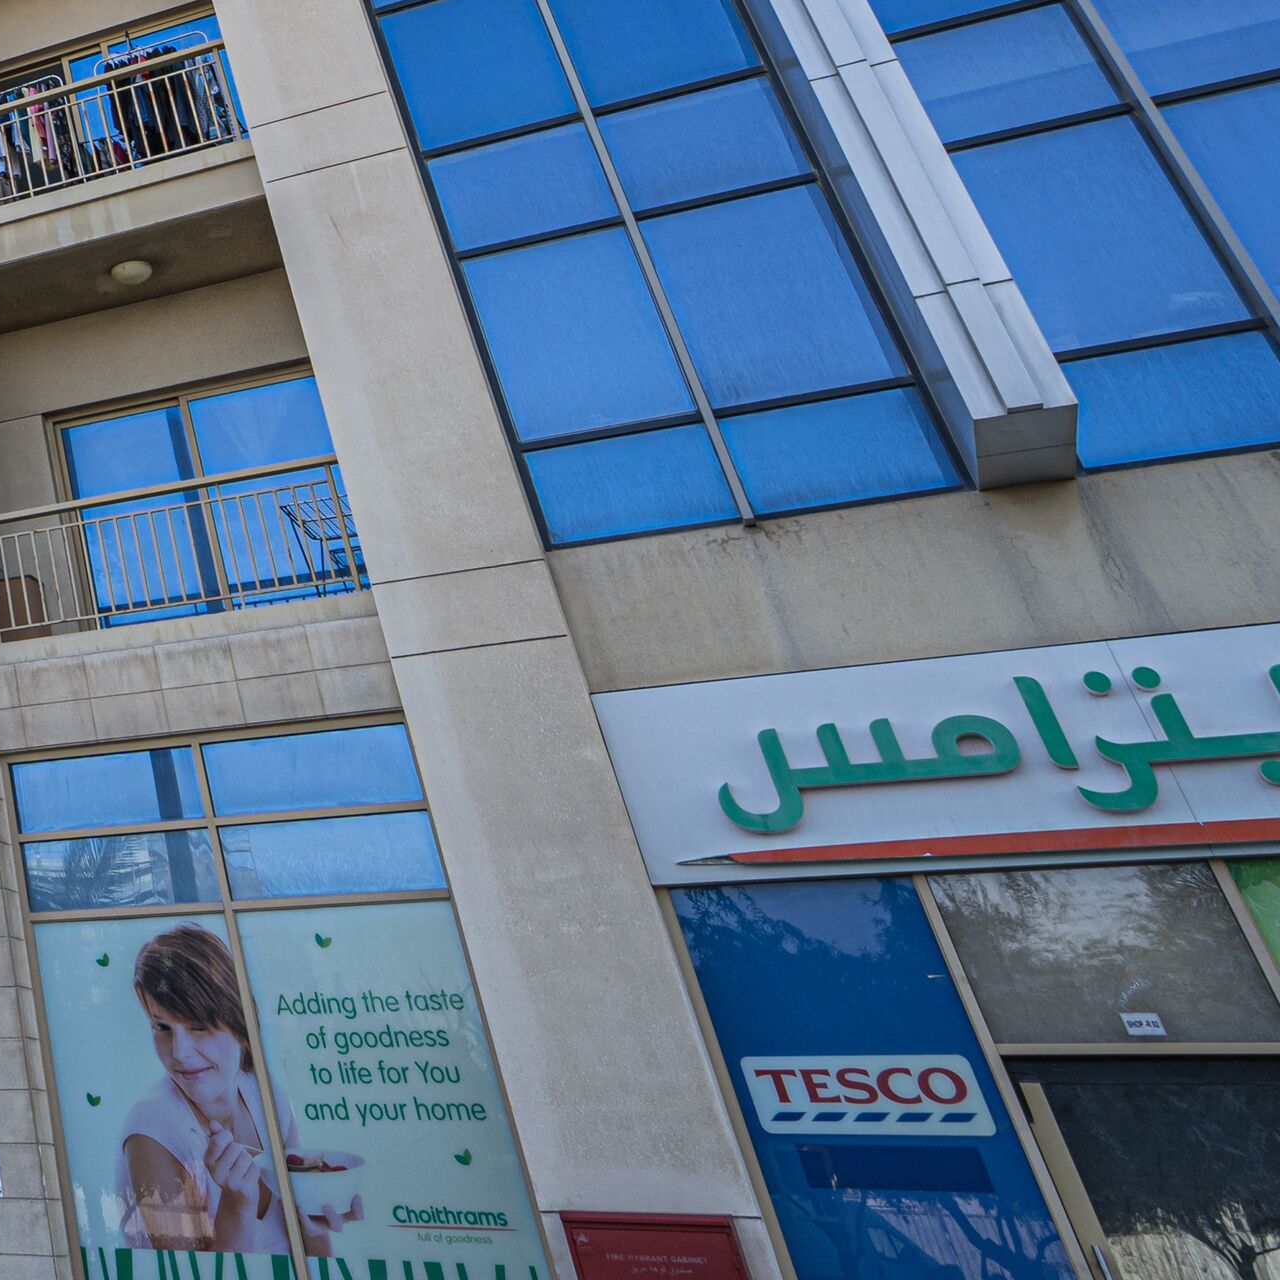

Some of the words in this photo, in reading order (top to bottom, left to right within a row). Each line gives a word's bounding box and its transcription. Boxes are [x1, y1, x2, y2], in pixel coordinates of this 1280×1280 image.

[277, 991, 357, 1020] Adding
[361, 990, 400, 1013] the
[404, 989, 465, 1012] taste
[306, 1026, 327, 1050] of
[334, 1024, 450, 1055] goodness
[310, 1063, 333, 1085] to
[338, 1060, 373, 1085] life
[378, 1060, 409, 1084] for
[414, 1061, 461, 1084] You
[754, 1066, 968, 1105] TESCO
[304, 1096, 350, 1122] and
[355, 1102, 407, 1128] your
[413, 1096, 487, 1122] home
[392, 1204, 509, 1227] Choithrams
[417, 1232, 432, 1242] full
[434, 1232, 443, 1243] of
[445, 1234, 493, 1245] goodness
[670, 1255, 710, 1265] CABINET
